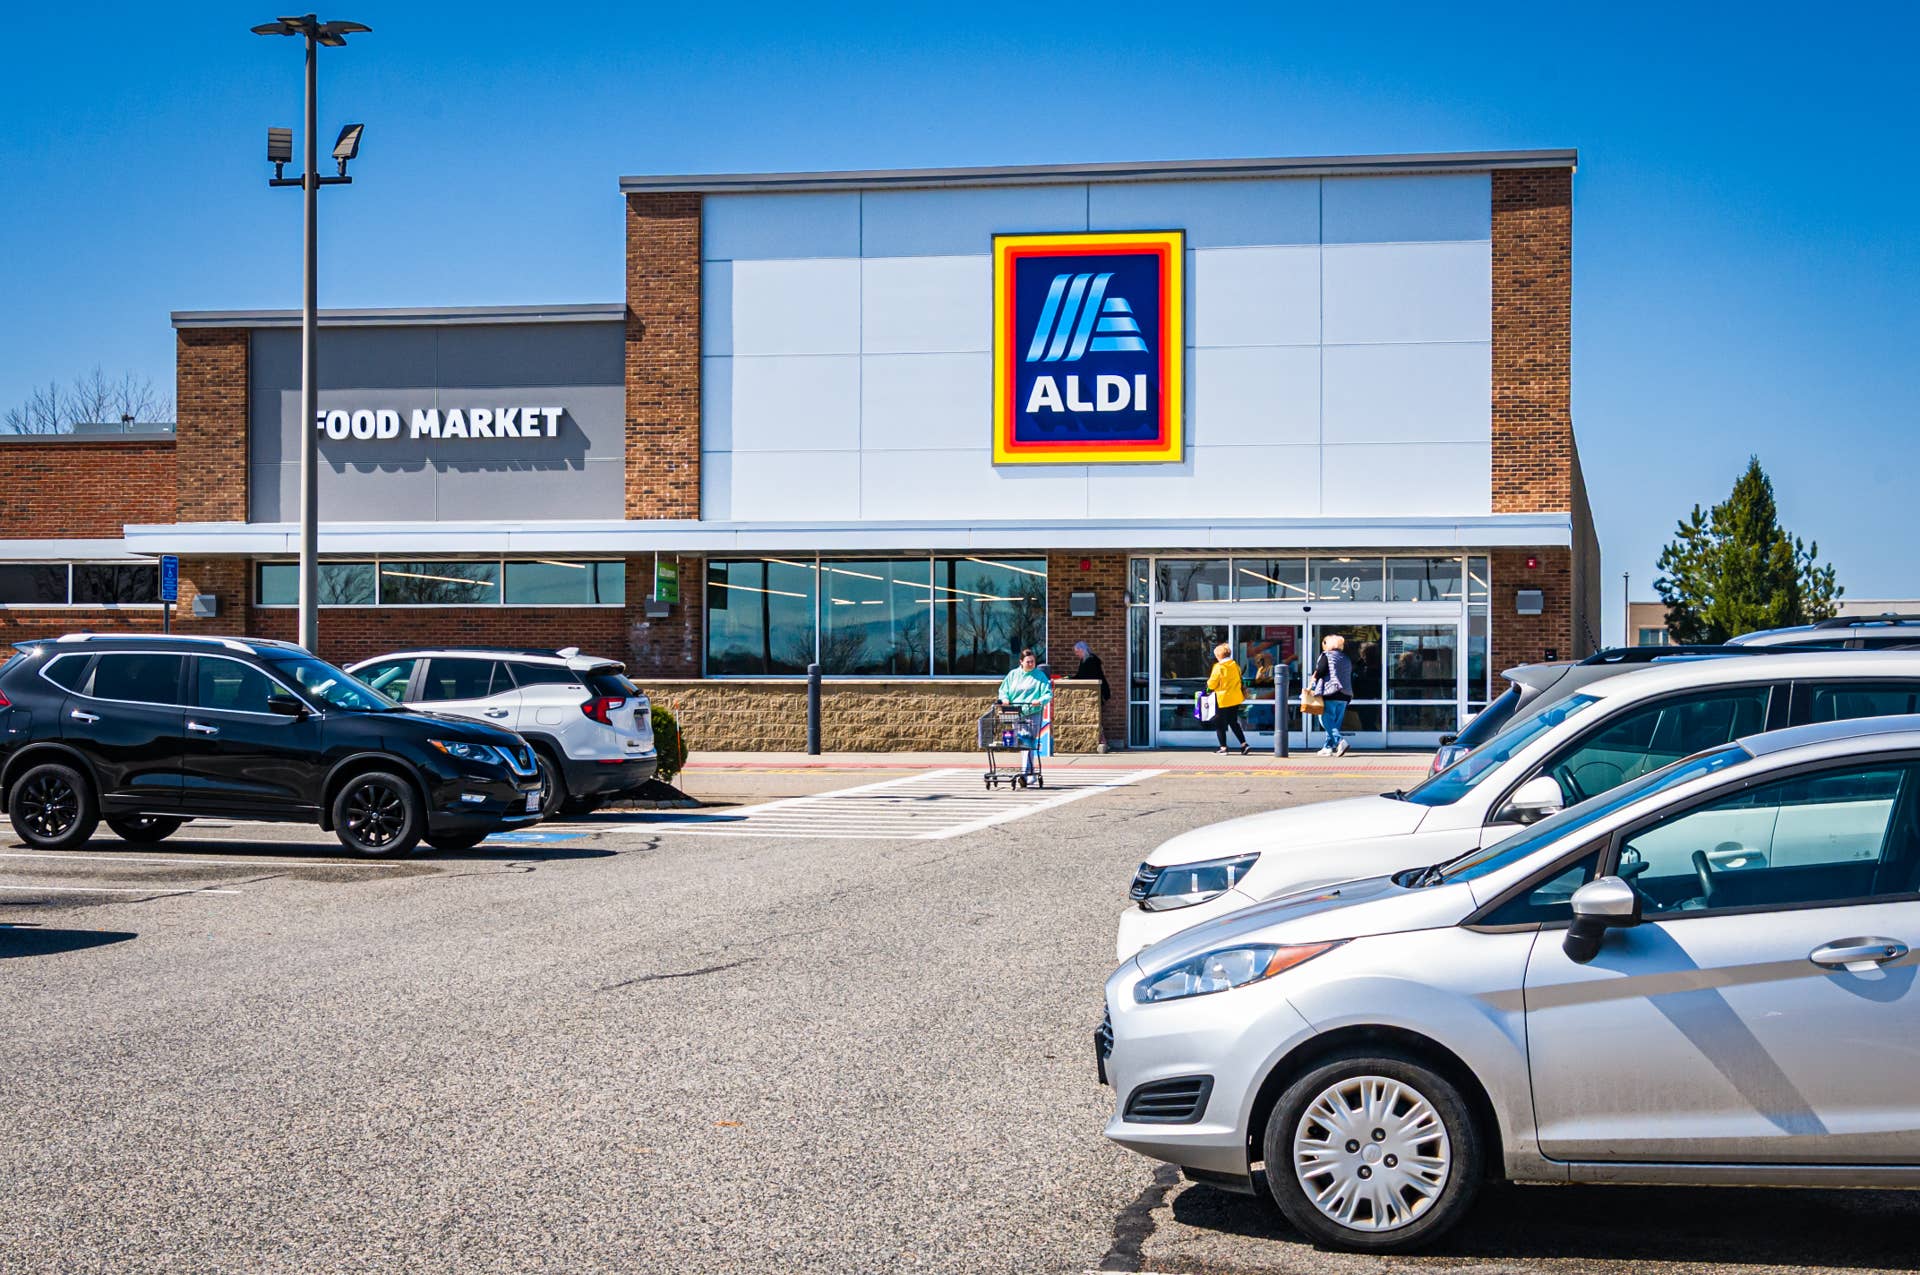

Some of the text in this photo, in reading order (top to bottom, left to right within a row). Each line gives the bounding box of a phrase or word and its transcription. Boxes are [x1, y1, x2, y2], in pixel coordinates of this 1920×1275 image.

[1026, 374, 1147, 413] ALDI
[410, 407, 563, 438] MARKET
[1331, 576, 1361, 591] 246
